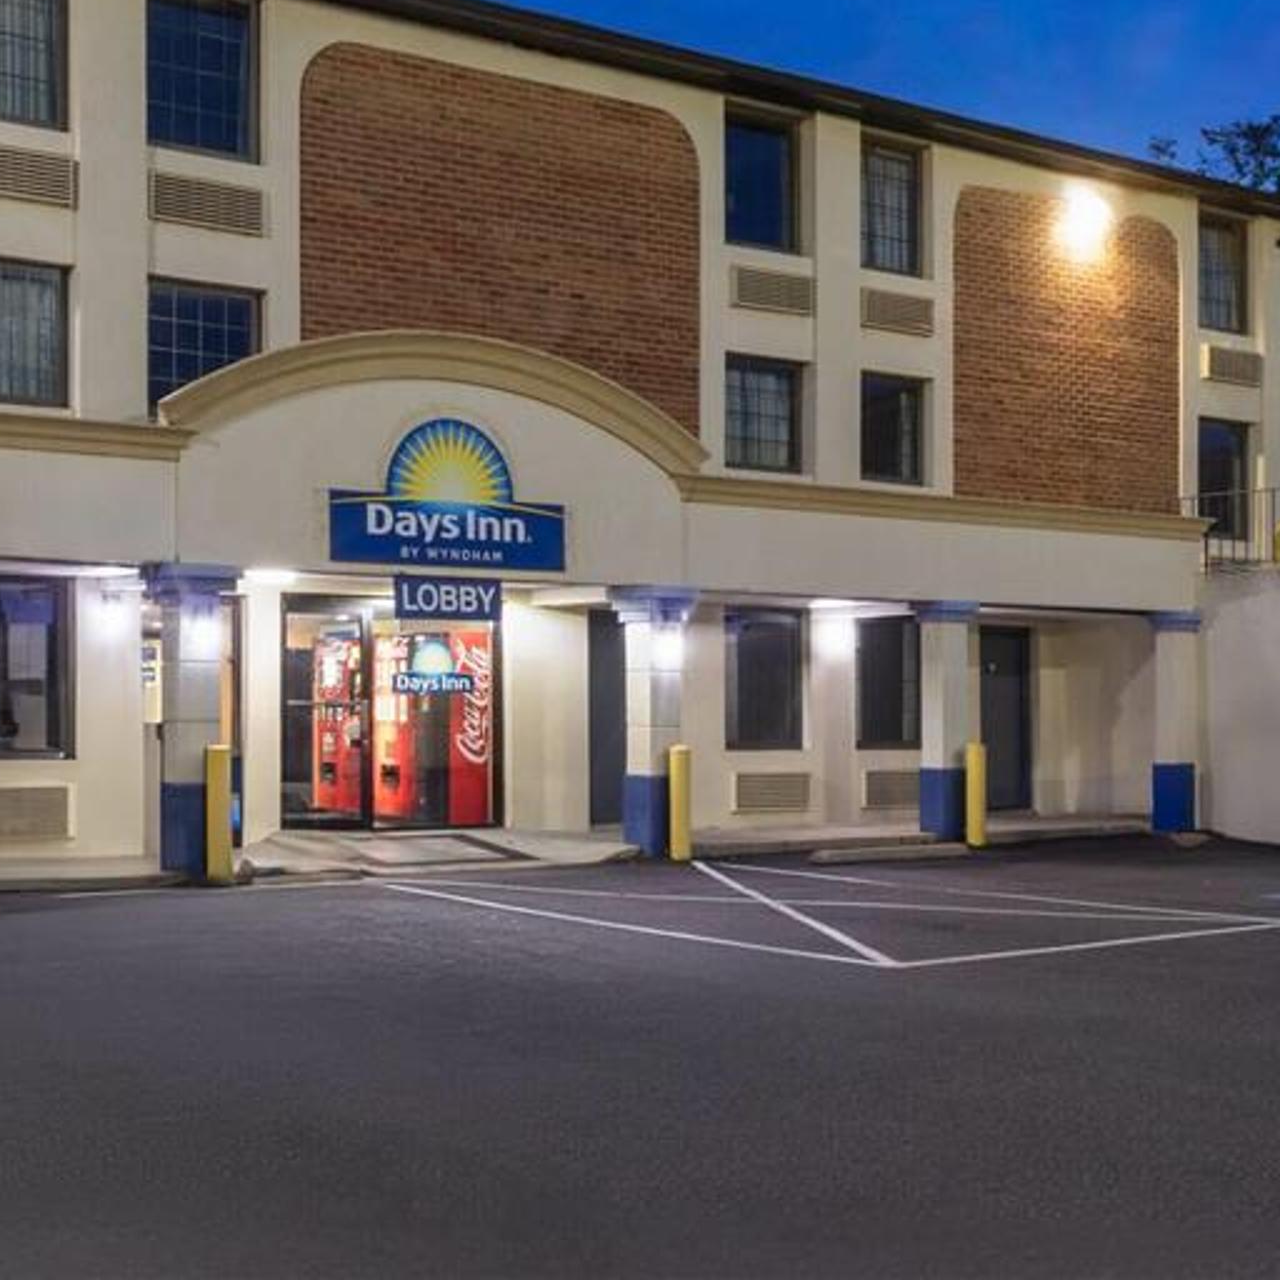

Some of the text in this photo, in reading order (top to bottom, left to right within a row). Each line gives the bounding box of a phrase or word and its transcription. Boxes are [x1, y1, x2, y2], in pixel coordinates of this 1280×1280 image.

[366, 502, 526, 543] Days Inn
[400, 546, 503, 562] BY WYNDHAM
[402, 582, 496, 613] LOBBY
[396, 674, 471, 695] Days Inn
